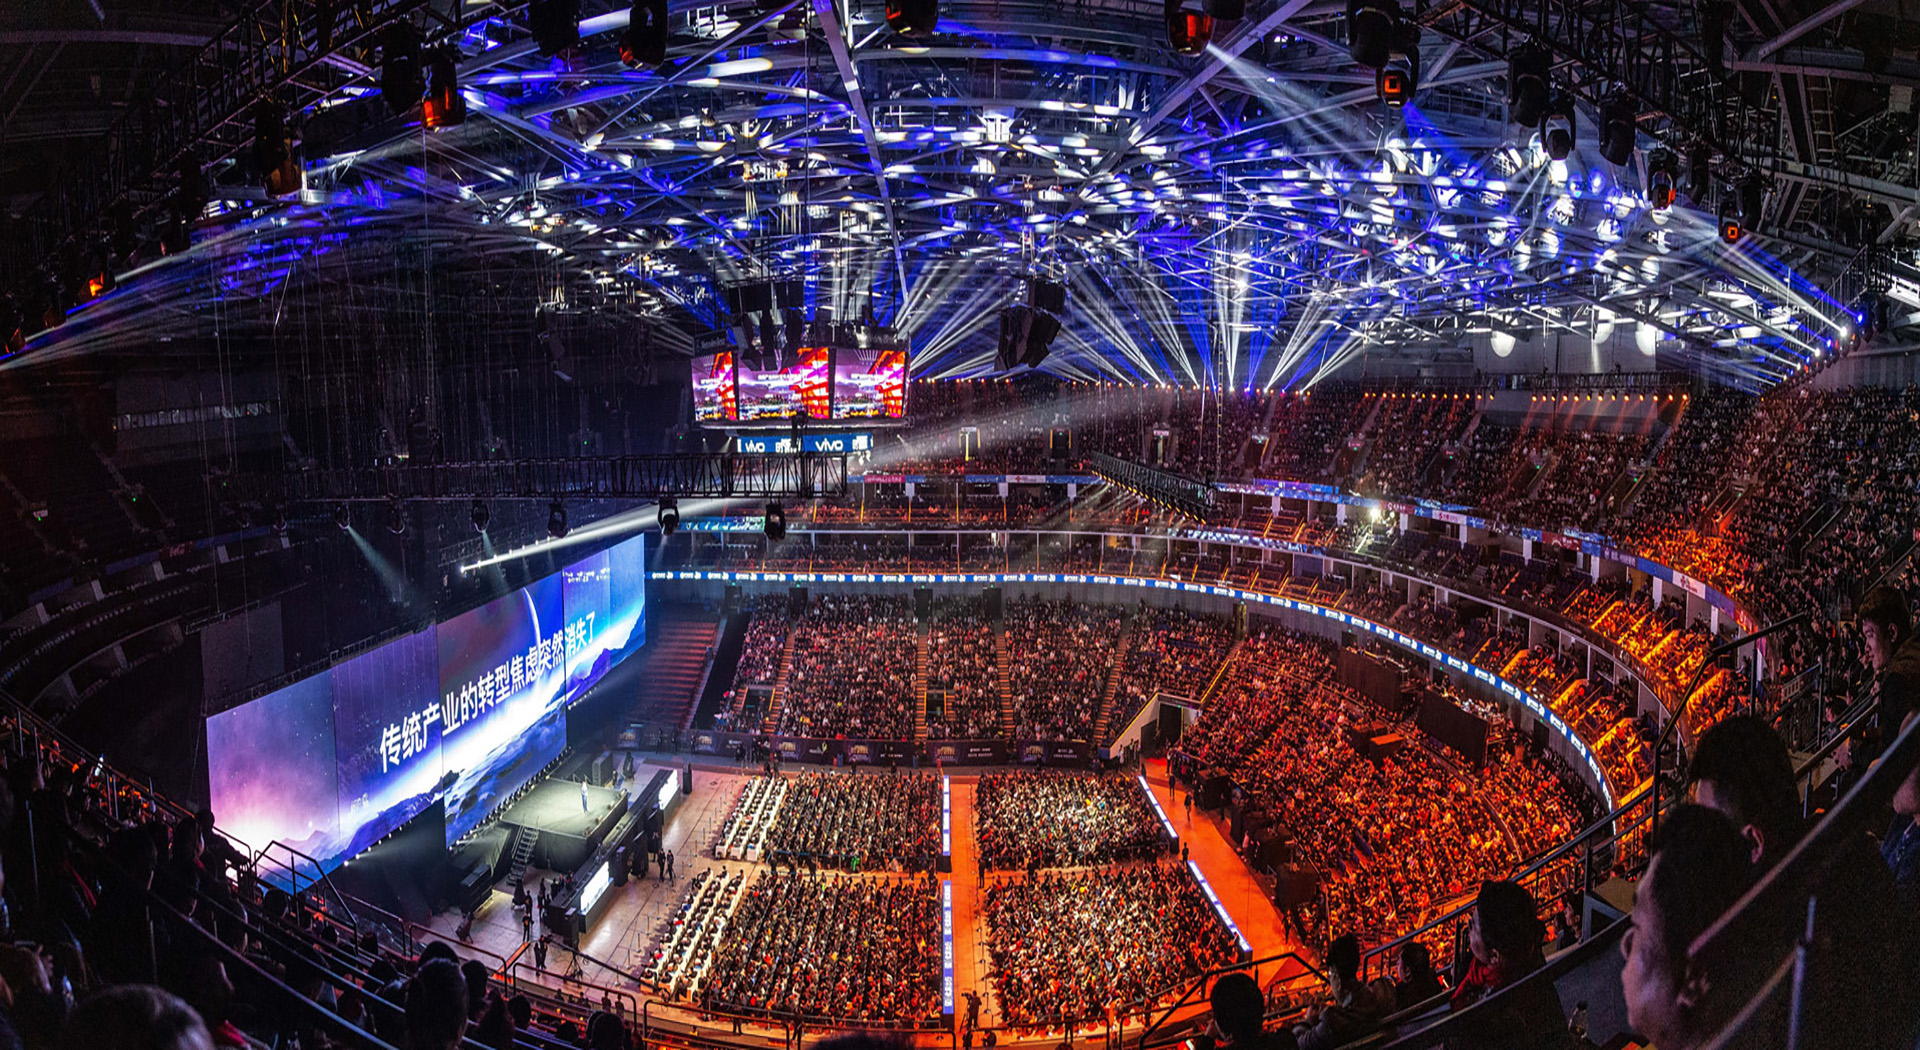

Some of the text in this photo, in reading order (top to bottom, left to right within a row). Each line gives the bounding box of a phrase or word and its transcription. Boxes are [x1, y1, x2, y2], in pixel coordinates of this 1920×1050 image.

[745, 439, 766, 453] vivo
[815, 437, 844, 452] vivo
[379, 611, 596, 774] 传统产业的转型焦虑突然消失了
